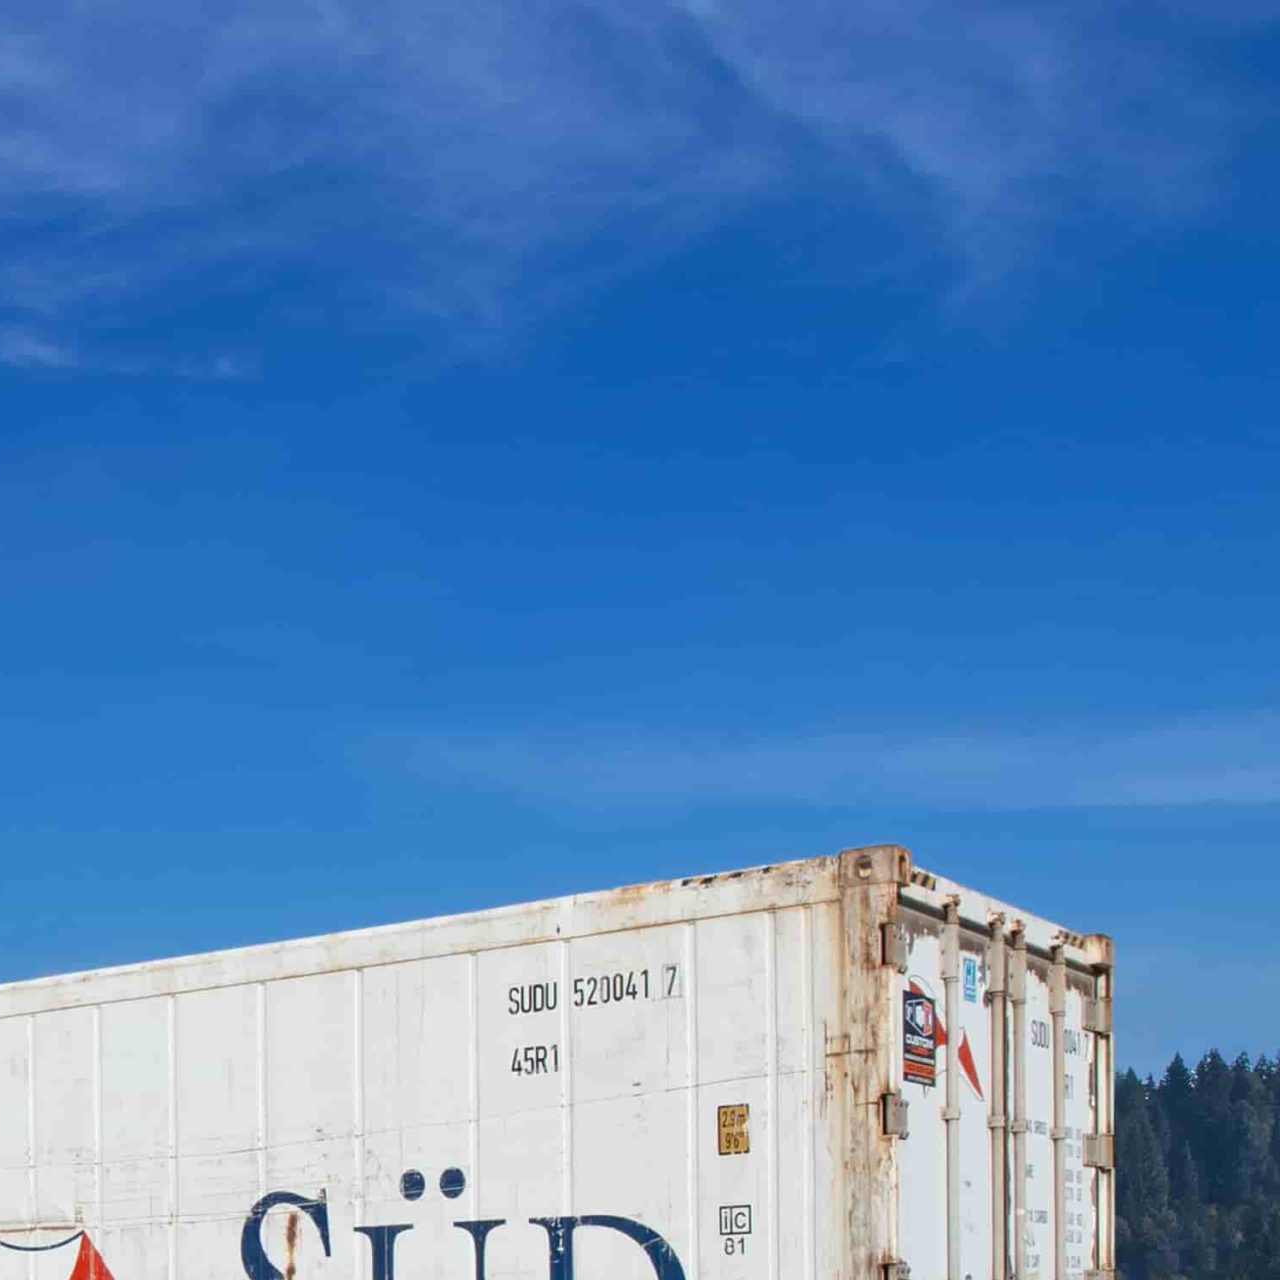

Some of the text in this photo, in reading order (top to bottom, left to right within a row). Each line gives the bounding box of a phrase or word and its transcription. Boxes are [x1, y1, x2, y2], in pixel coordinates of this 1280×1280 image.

[509, 966, 677, 1014] SUDU 520041 7
[511, 1044, 559, 1076] 45R1
[724, 1237, 745, 1256] 81
